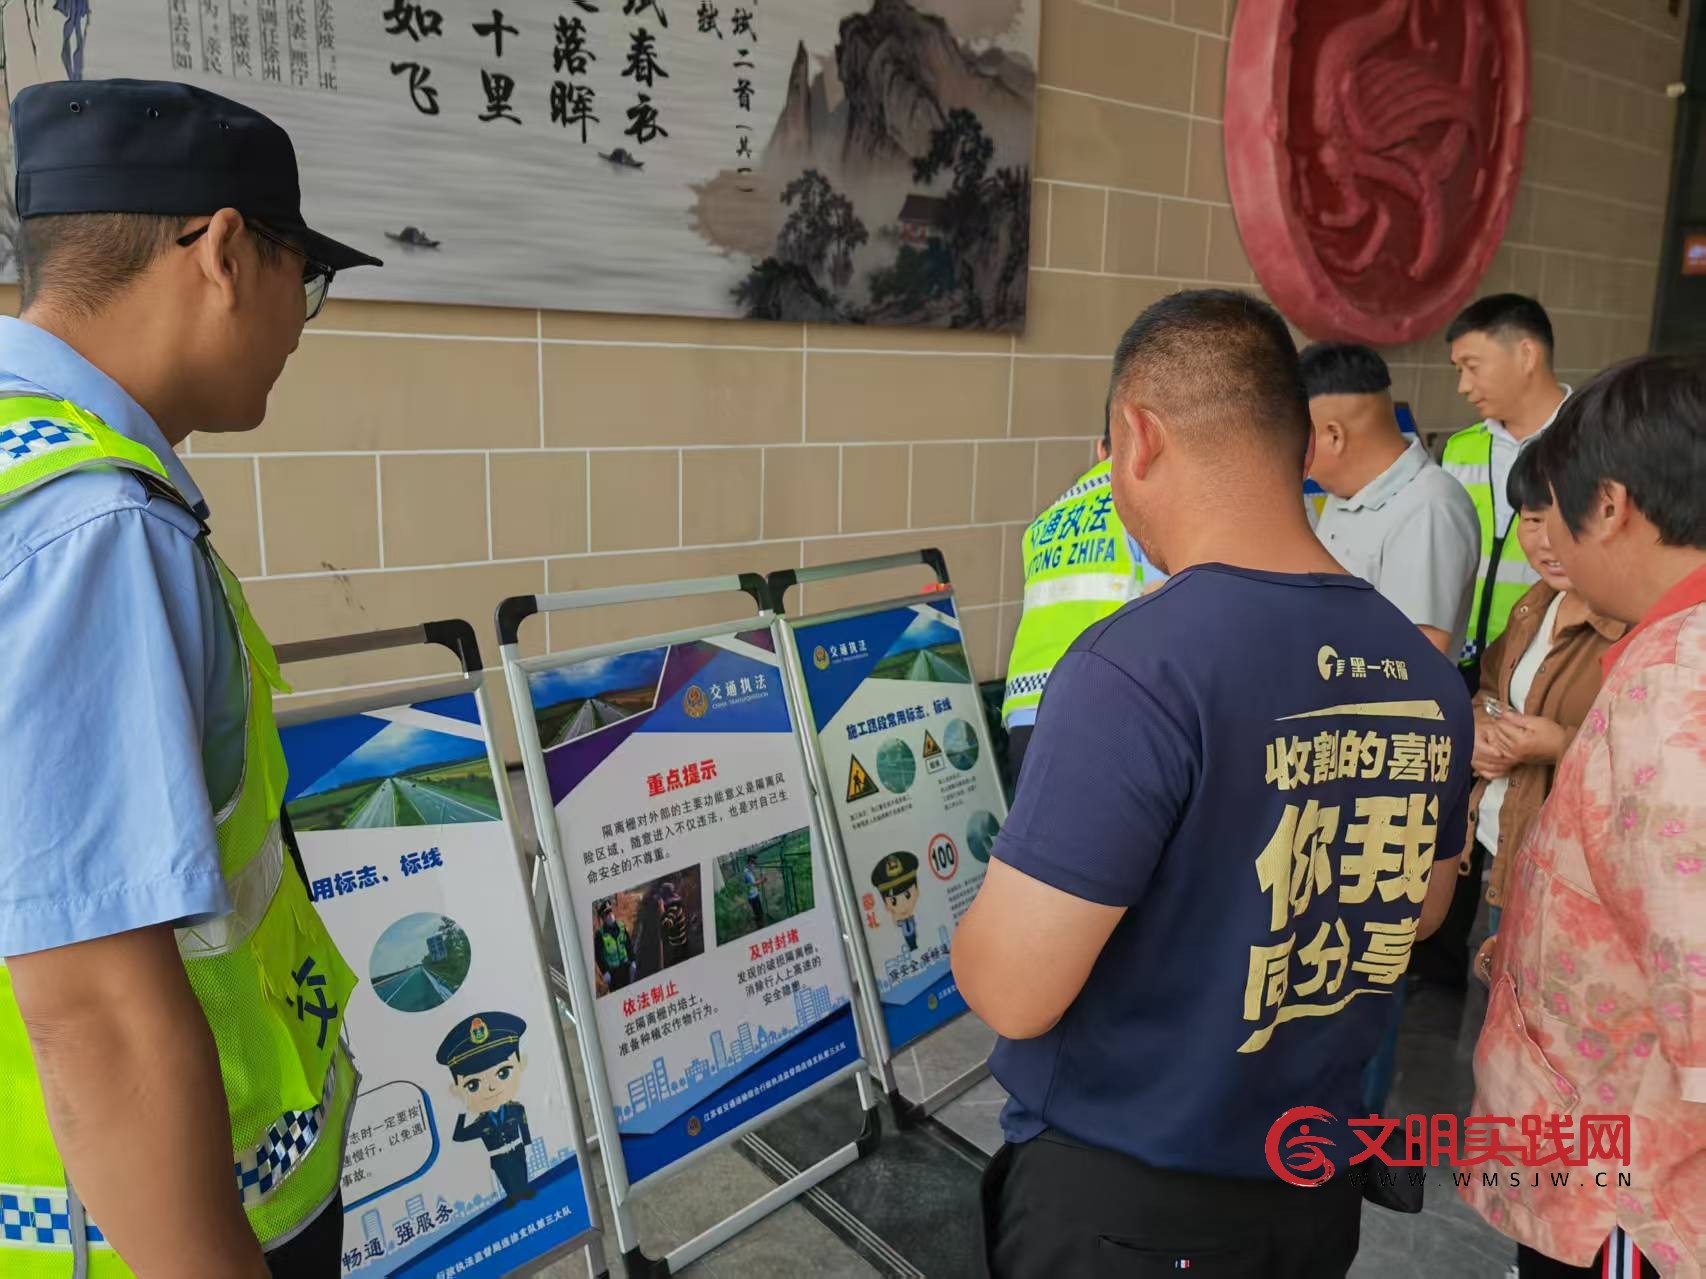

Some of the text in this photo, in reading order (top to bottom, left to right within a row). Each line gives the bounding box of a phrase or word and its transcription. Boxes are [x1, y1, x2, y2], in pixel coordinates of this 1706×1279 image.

[383, 0, 443, 115] 如飞
[472, 9, 522, 125] 十里
[550, 0, 600, 143] 落晖
[1067, 537, 1116, 565] ZHIFA
[709, 674, 767, 700] 交通执法
[1350, 657, 1408, 680] 黑一农服
[646, 759, 718, 797] 重点提示
[1265, 729, 1452, 791] 收割的喜悦
[602, 772, 786, 839] 隔离栅对外部的主要功能意义是隔离风
[932, 843, 955, 871] 100
[1255, 793, 1438, 932] 你我
[749, 928, 799, 961] 及时封堵
[1242, 916, 1420, 1021] 同分享
[622, 980, 680, 1017] 依法制止
[342, 1203, 454, 1272] 畅通 强服务
